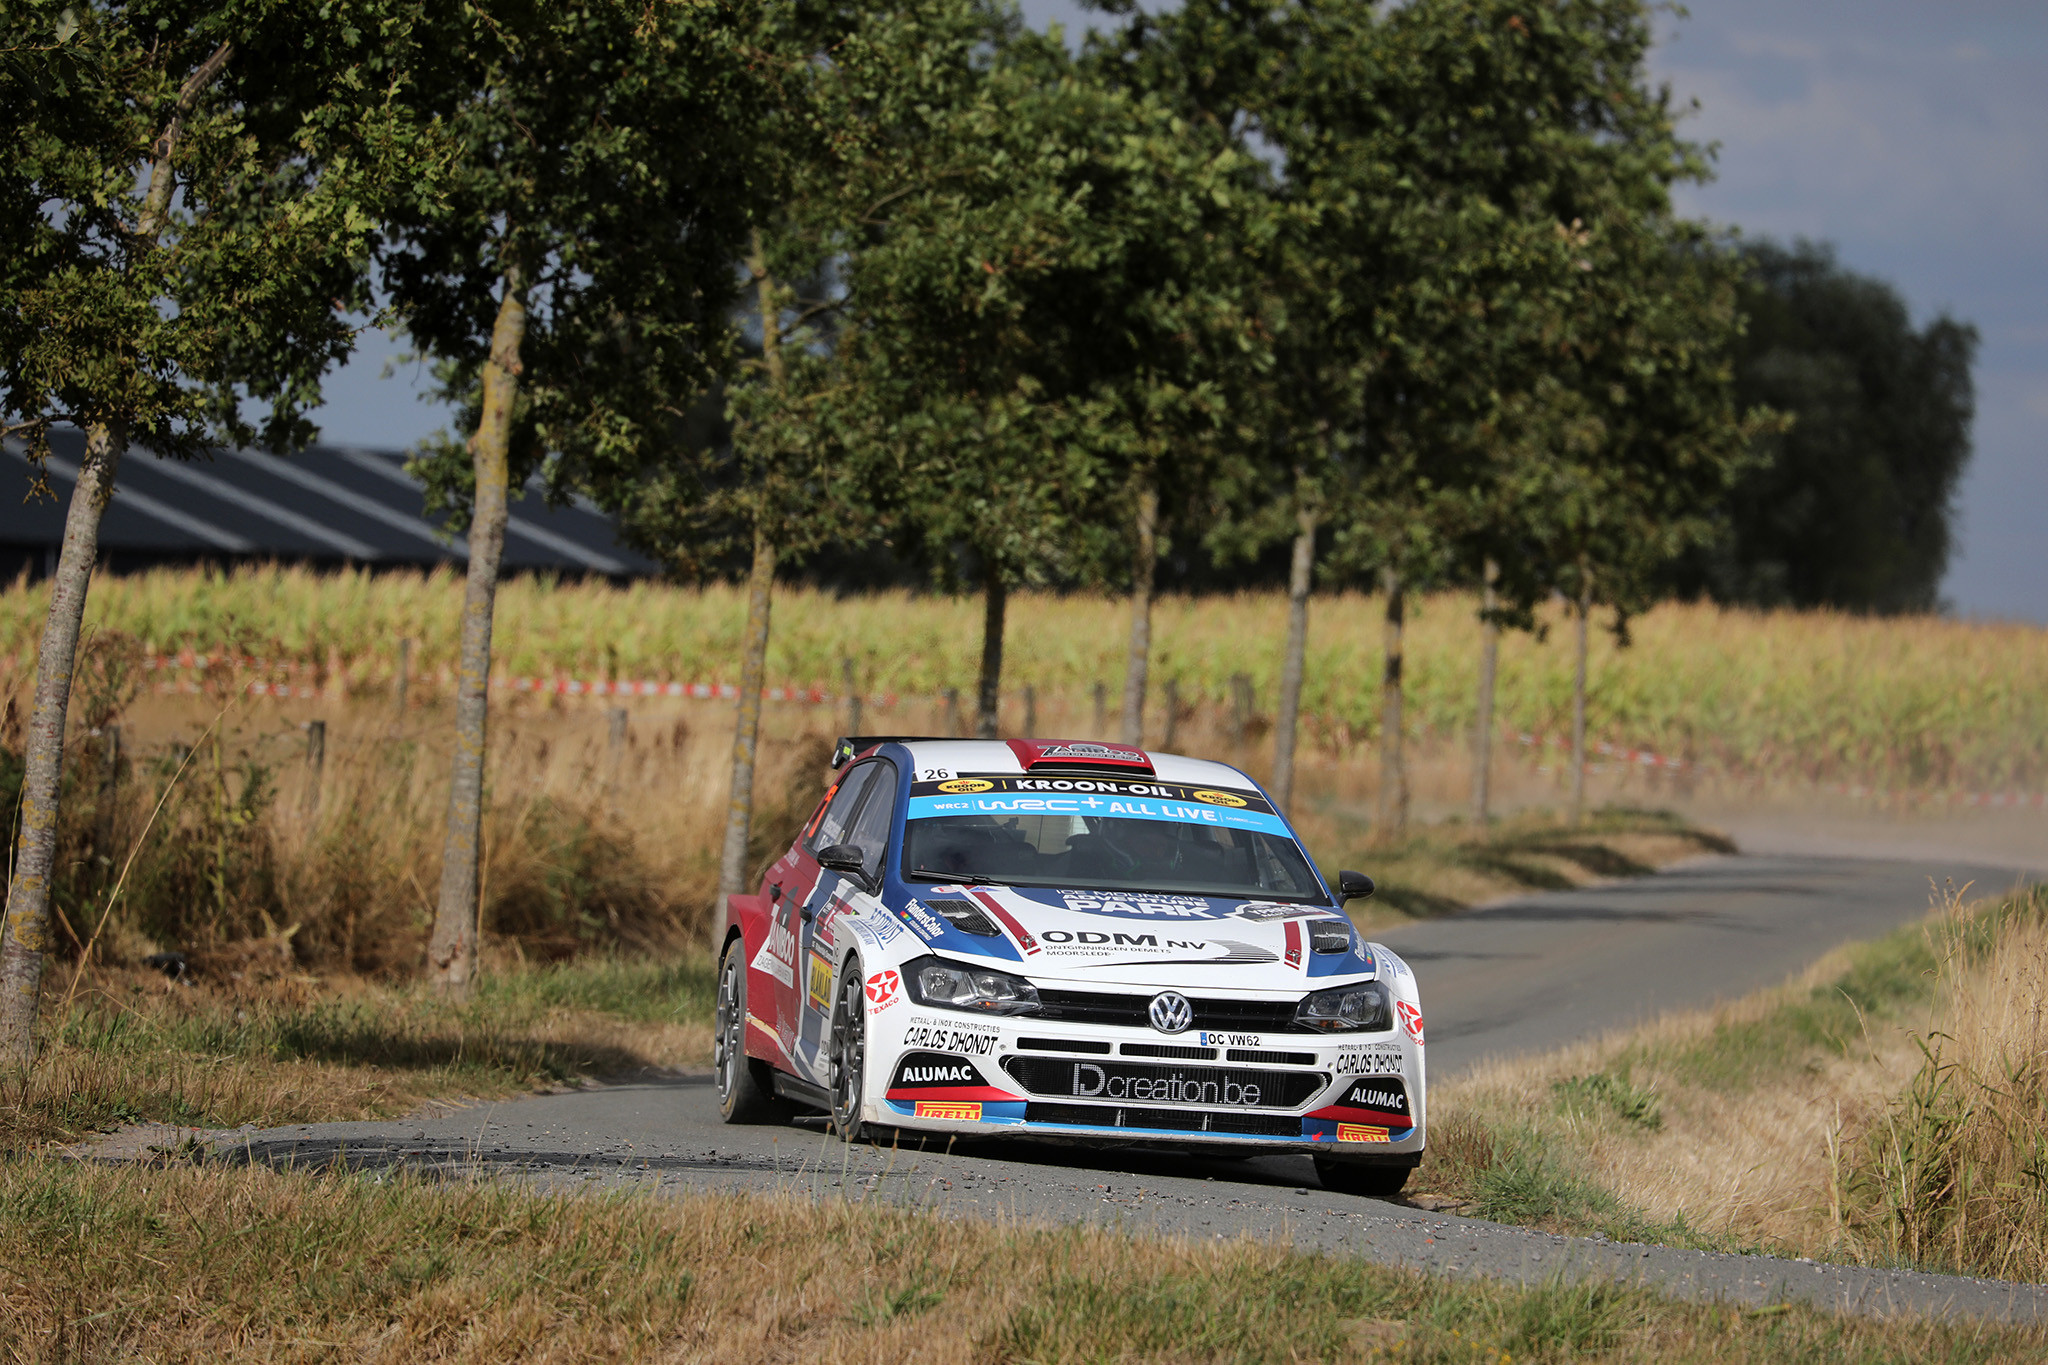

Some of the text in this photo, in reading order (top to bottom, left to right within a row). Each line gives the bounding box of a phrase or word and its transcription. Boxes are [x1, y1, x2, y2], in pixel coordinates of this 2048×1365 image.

[925, 768, 949, 780] 26
[1015, 779, 1173, 798] KROON-OIL
[934, 802, 969, 810] WRC2
[1109, 801, 1157, 816] ALL
[1162, 805, 1218, 822] LIVE
[1062, 895, 1210, 907] ADVENTURE
[1093, 890, 1205, 902] MOUNTAIN
[905, 898, 945, 938] FlandersColor
[1064, 899, 1218, 919] PARK
[1041, 930, 1208, 950] ODM NV
[867, 997, 899, 1015] TEXACO
[938, 1019, 953, 1027] INOX
[954, 1021, 1000, 1033] CONSTRUCTIES
[903, 1027, 999, 1056] CARLOS DHONDT
[1208, 1033, 1261, 1047] OC VW62
[902, 1065, 972, 1082] ALUMAC
[1336, 1054, 1403, 1074] CARLOS DHONDT
[1349, 1086, 1404, 1109] ALUMAC
[915, 1102, 982, 1120] PIRELLI
[1337, 1123, 1390, 1142] PIRELLI
